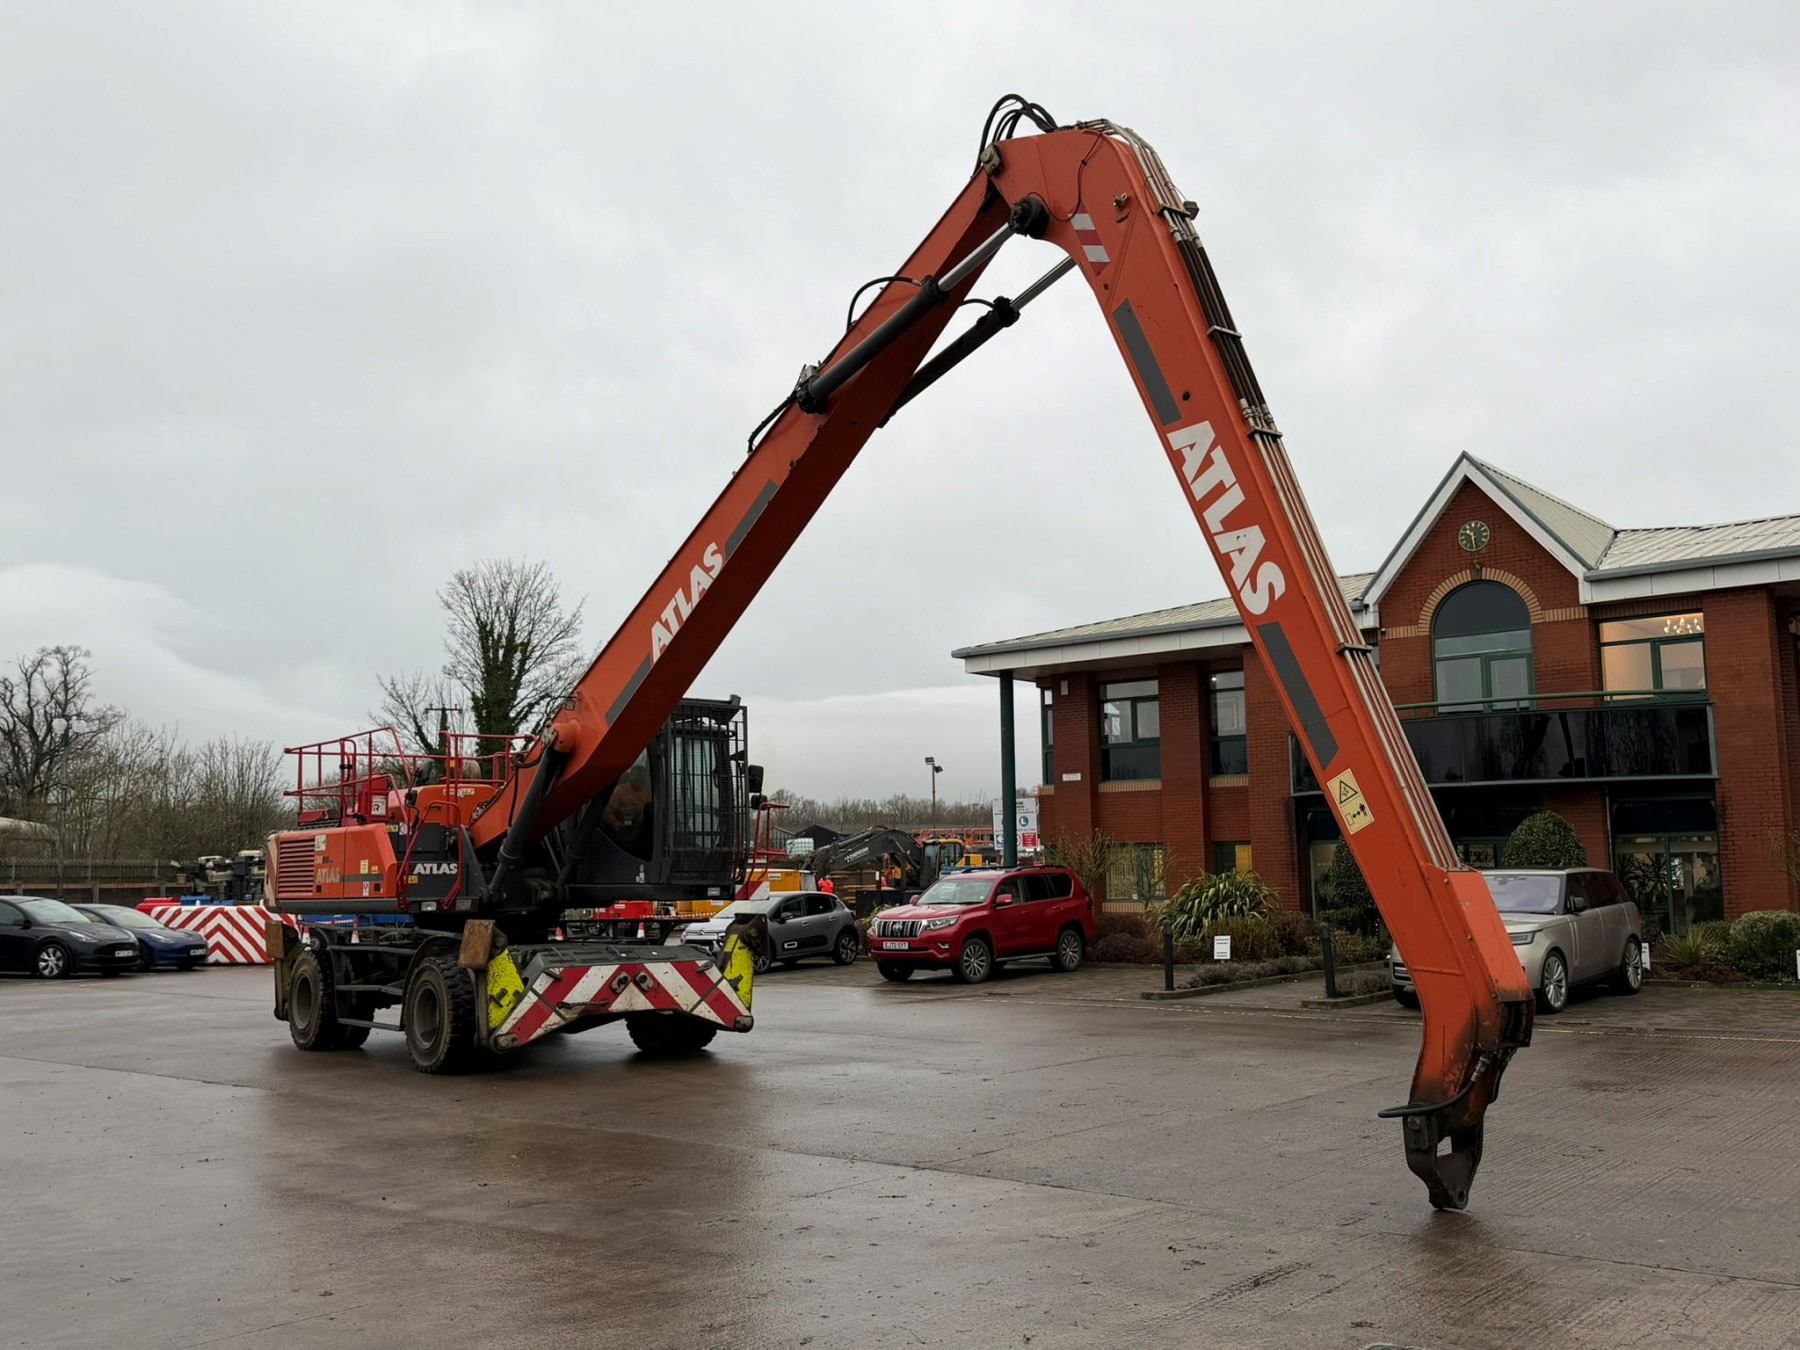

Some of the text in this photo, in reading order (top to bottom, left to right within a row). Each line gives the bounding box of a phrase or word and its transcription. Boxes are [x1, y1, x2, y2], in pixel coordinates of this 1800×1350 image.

[1166, 420, 1286, 615] ATLAS
[651, 542, 723, 663] ATLAS
[315, 866, 341, 883] ATLAS
[413, 862, 458, 875] ATLAS
